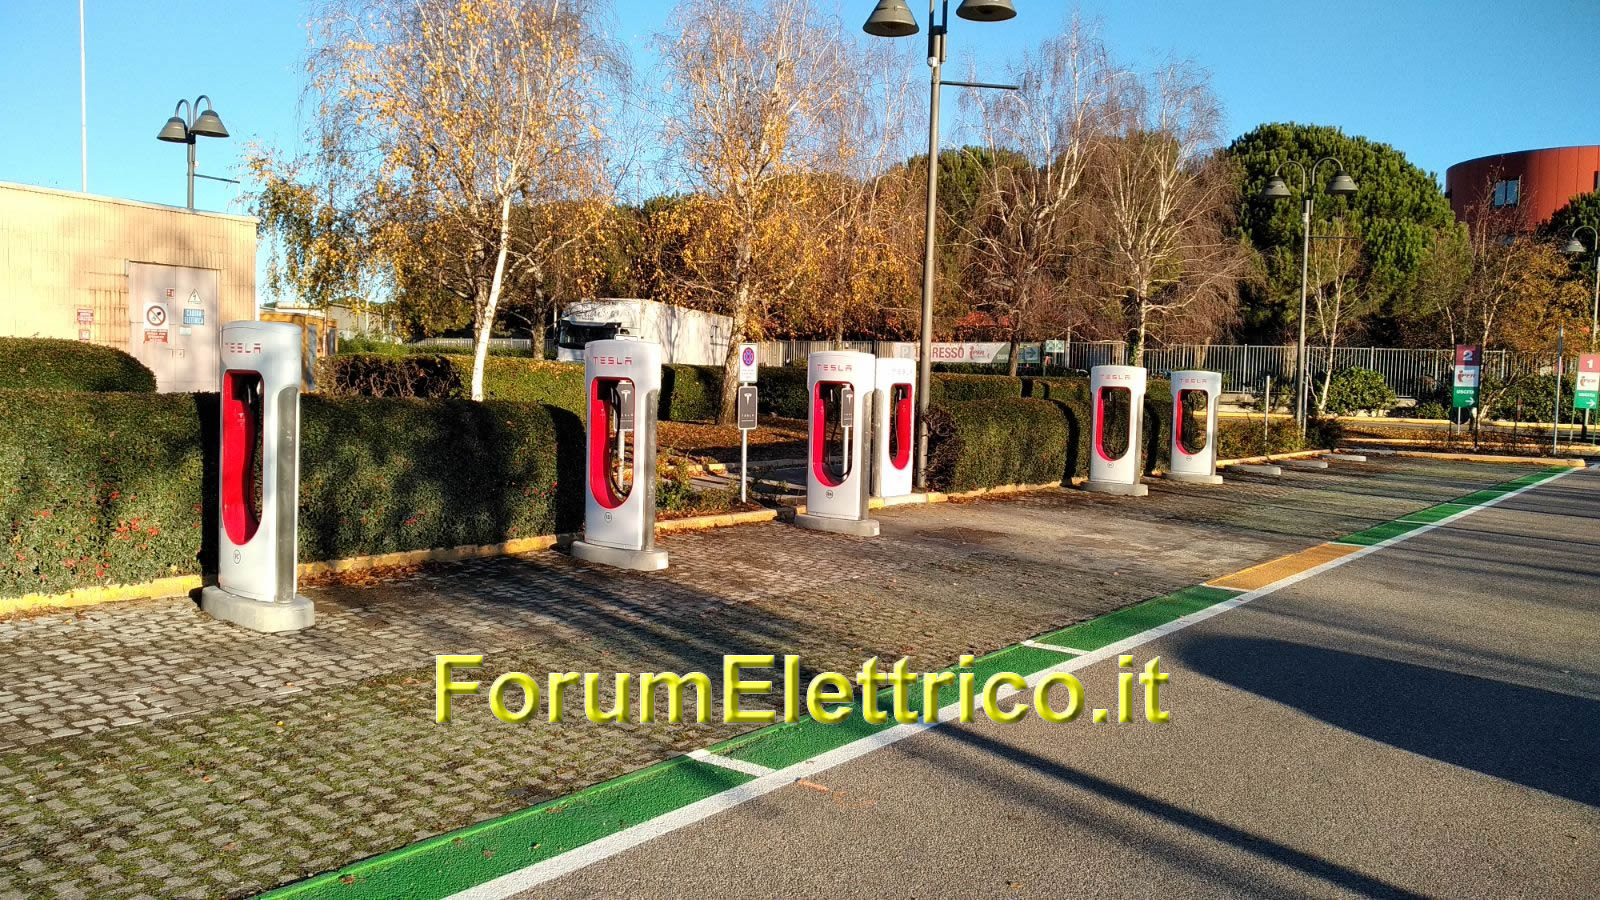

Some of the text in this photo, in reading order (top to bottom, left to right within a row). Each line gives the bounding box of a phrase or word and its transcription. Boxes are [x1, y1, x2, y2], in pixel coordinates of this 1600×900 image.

[224, 342, 261, 353] TESLA
[592, 356, 632, 365] TESLA
[1463, 350, 1473, 361] 2
[816, 363, 853, 372] TESLA
[1586, 359, 1594, 369] 1
